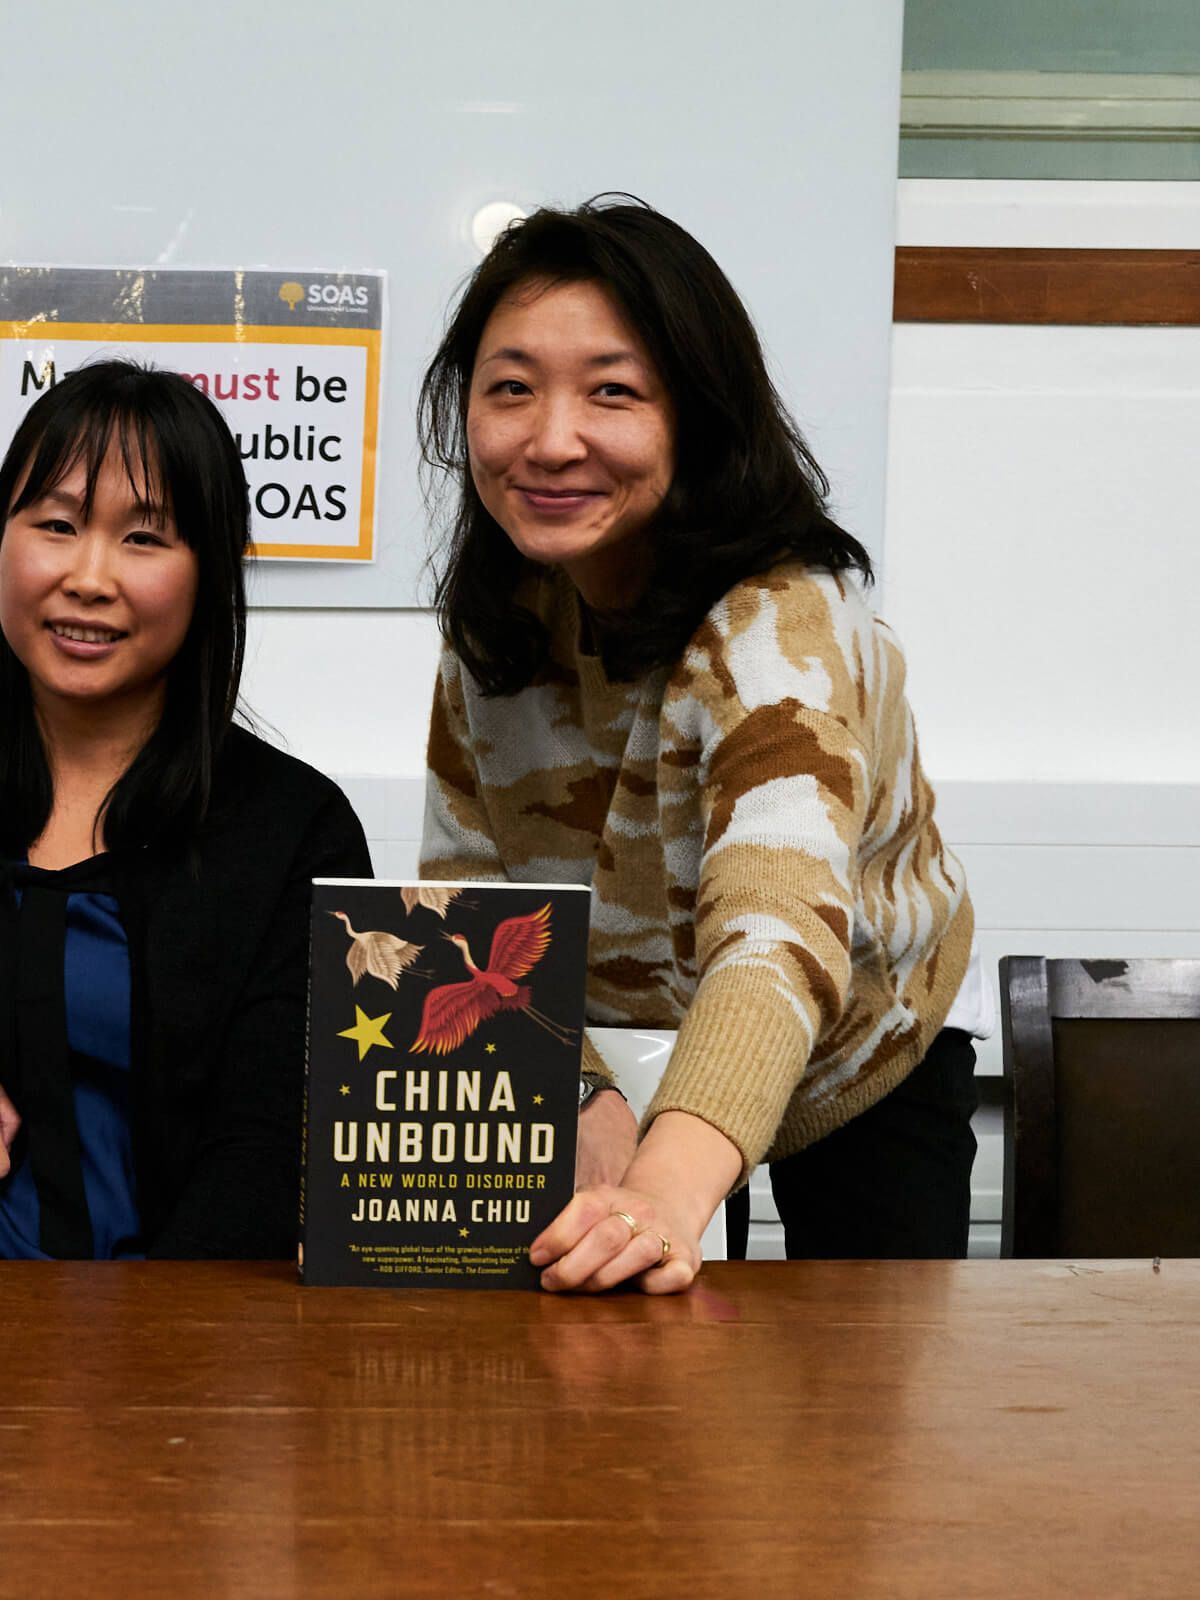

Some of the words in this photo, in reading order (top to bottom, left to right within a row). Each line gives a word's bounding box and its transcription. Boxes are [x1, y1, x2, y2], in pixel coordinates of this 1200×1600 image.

[308, 284, 369, 305] SOAS
[295, 365, 348, 404] be
[234, 424, 342, 462] ublic
[254, 482, 347, 521] OAS
[375, 1070, 517, 1112] CHINA
[333, 1121, 555, 1164] UNBOUND
[340, 1173, 351, 1189] A
[358, 1173, 393, 1189] NEW
[401, 1173, 458, 1190] WORLD
[466, 1173, 547, 1190] DISORDER
[351, 1198, 458, 1223] JOANNA
[471, 1199, 531, 1223] CHIU
